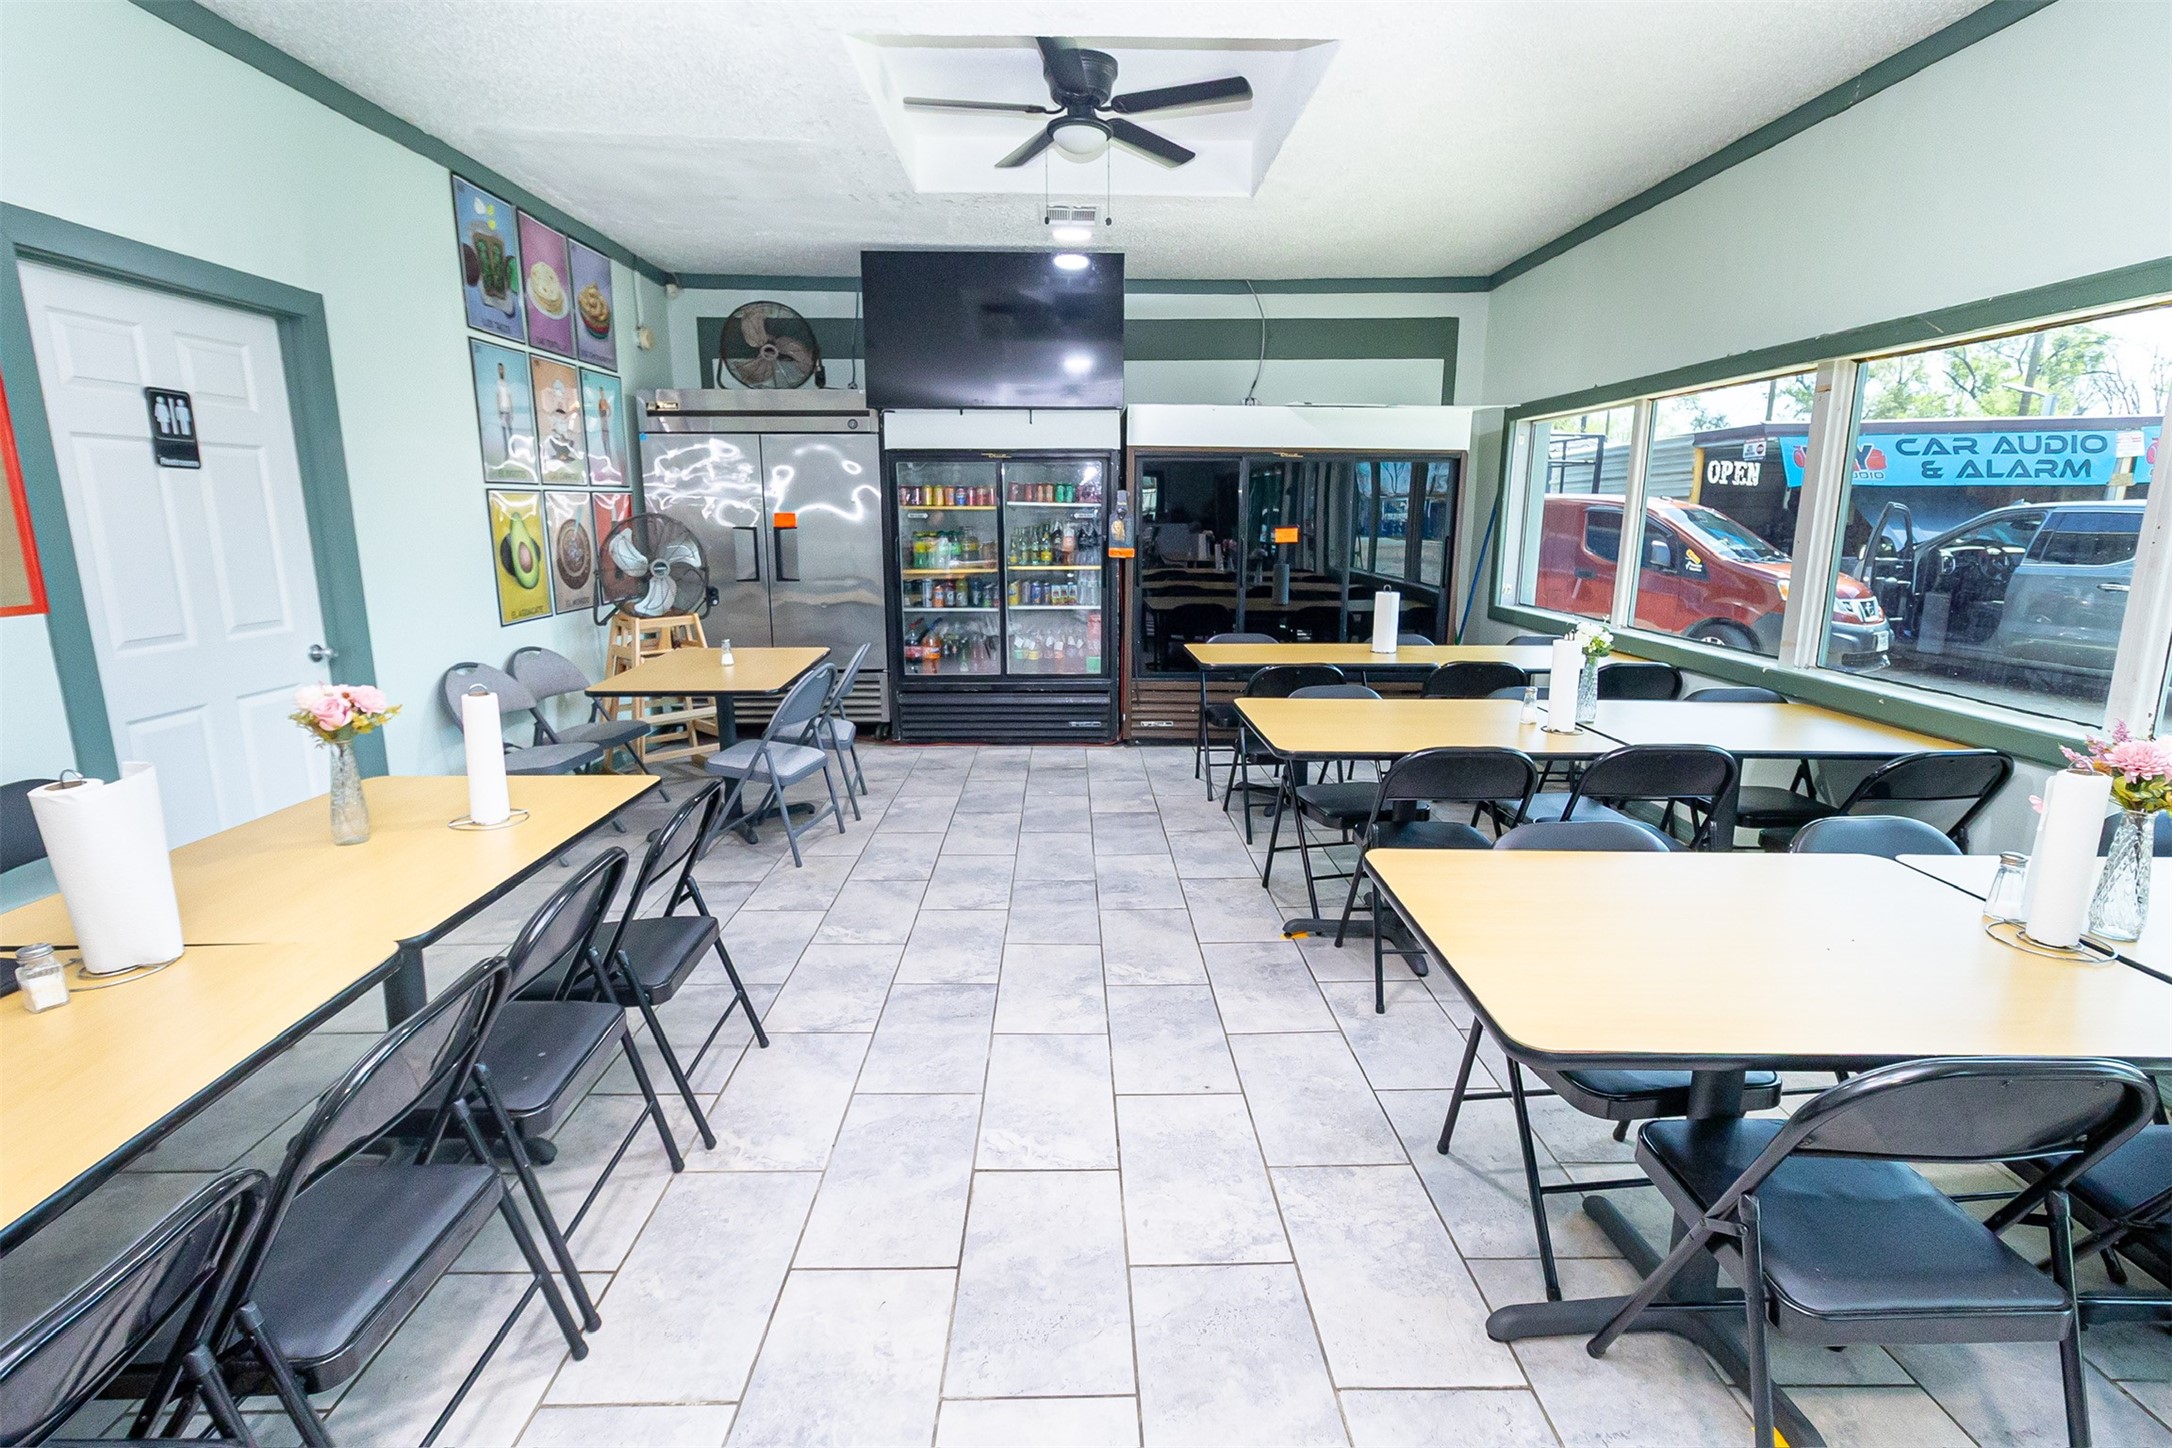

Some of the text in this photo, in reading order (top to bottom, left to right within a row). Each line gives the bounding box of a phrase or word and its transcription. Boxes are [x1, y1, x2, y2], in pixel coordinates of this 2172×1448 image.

[1895, 437, 1979, 456] CAR
[1991, 434, 2108, 455] AUDIO
[1707, 460, 1761, 487] OPEN
[1921, 458, 2092, 479] & ALARM
